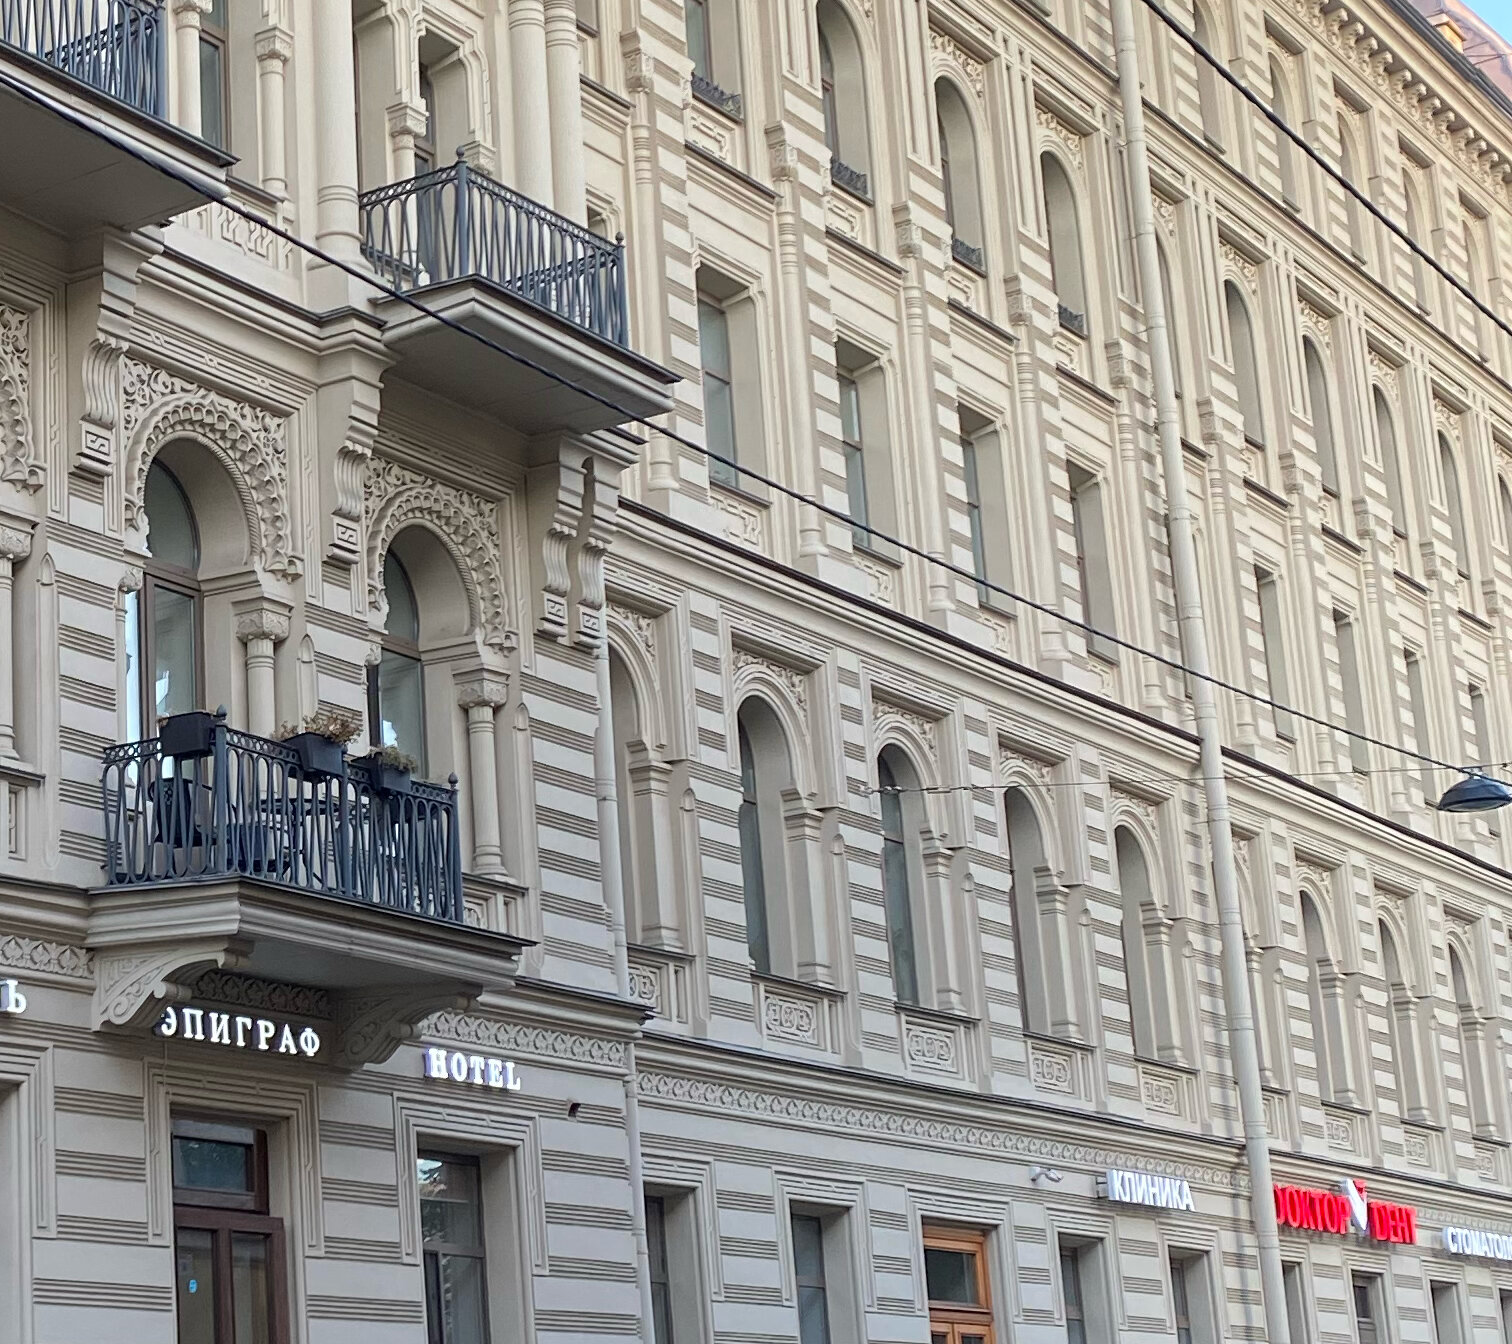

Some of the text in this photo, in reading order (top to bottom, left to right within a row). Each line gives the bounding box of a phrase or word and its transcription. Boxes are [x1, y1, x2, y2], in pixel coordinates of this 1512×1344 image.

[160, 1006, 321, 1056] ЭПИГРАФ
[427, 1047, 521, 1090] HOTEL
[1110, 1168, 1196, 1212] КЛИНИКА
[1446, 1226, 1512, 1261] СТОМАТОЛ
